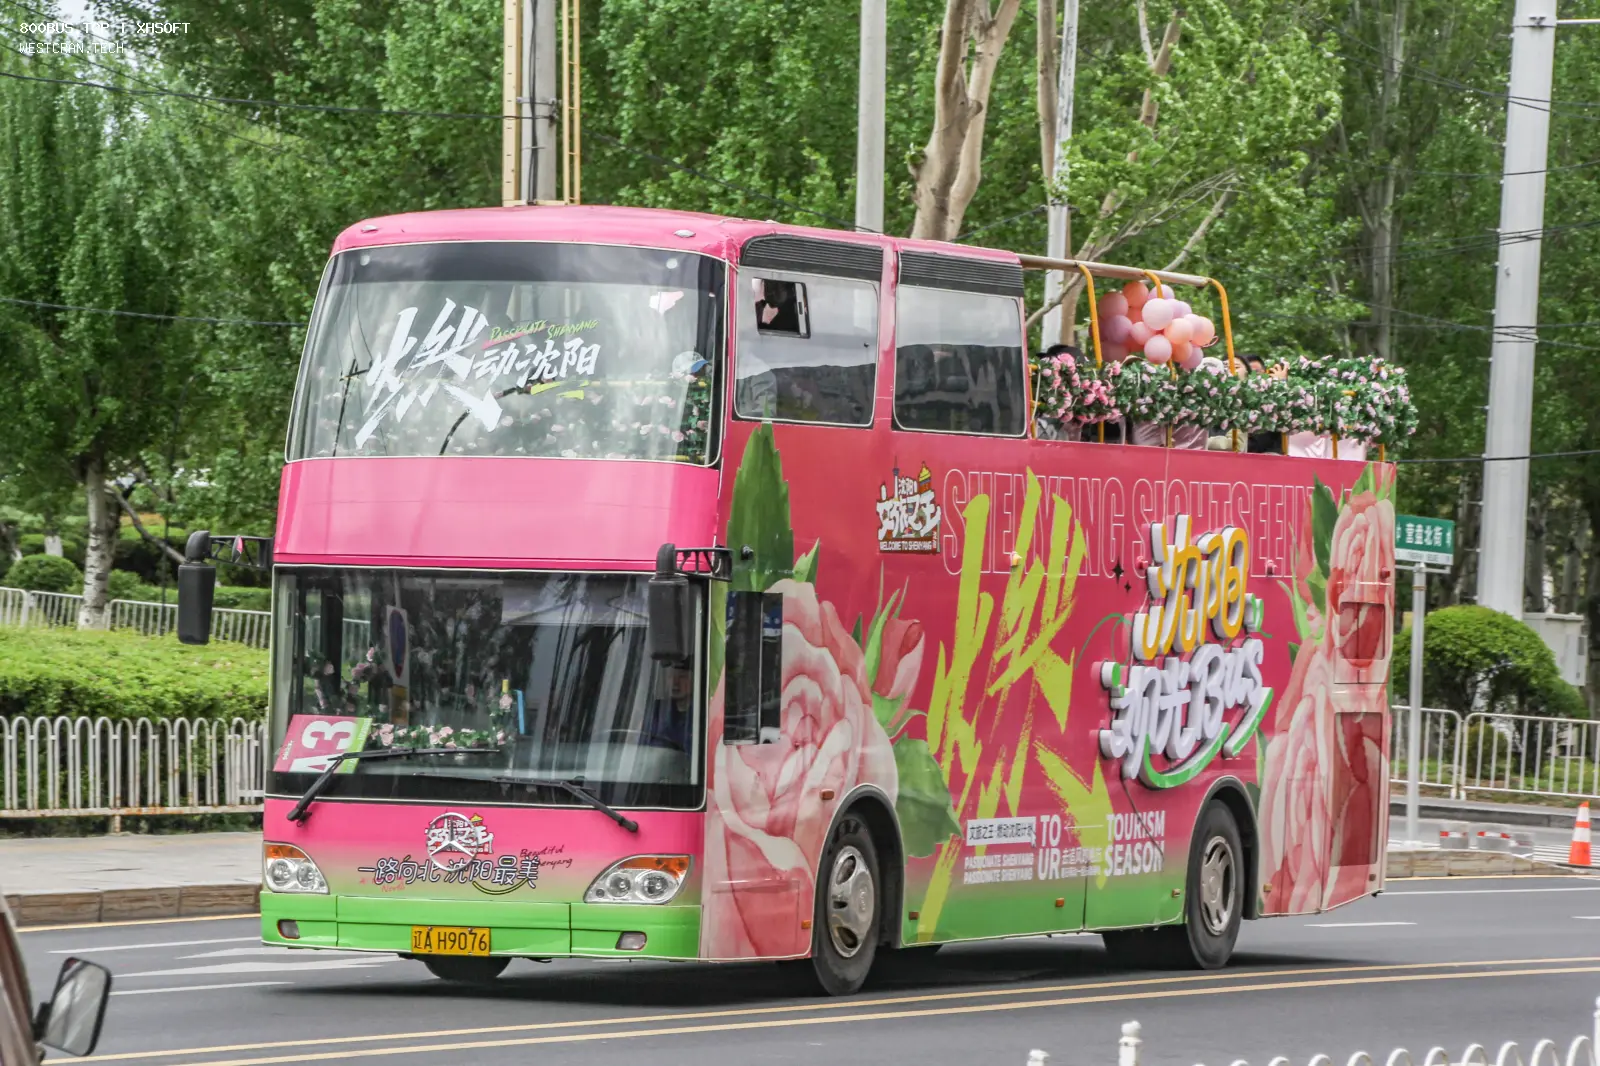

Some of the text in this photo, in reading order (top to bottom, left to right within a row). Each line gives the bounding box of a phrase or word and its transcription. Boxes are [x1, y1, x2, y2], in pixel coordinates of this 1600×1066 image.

[1106, 810, 1166, 841] TOURISM
[1104, 840, 1165, 877] SEASON
[437, 931, 488, 952] H9076
